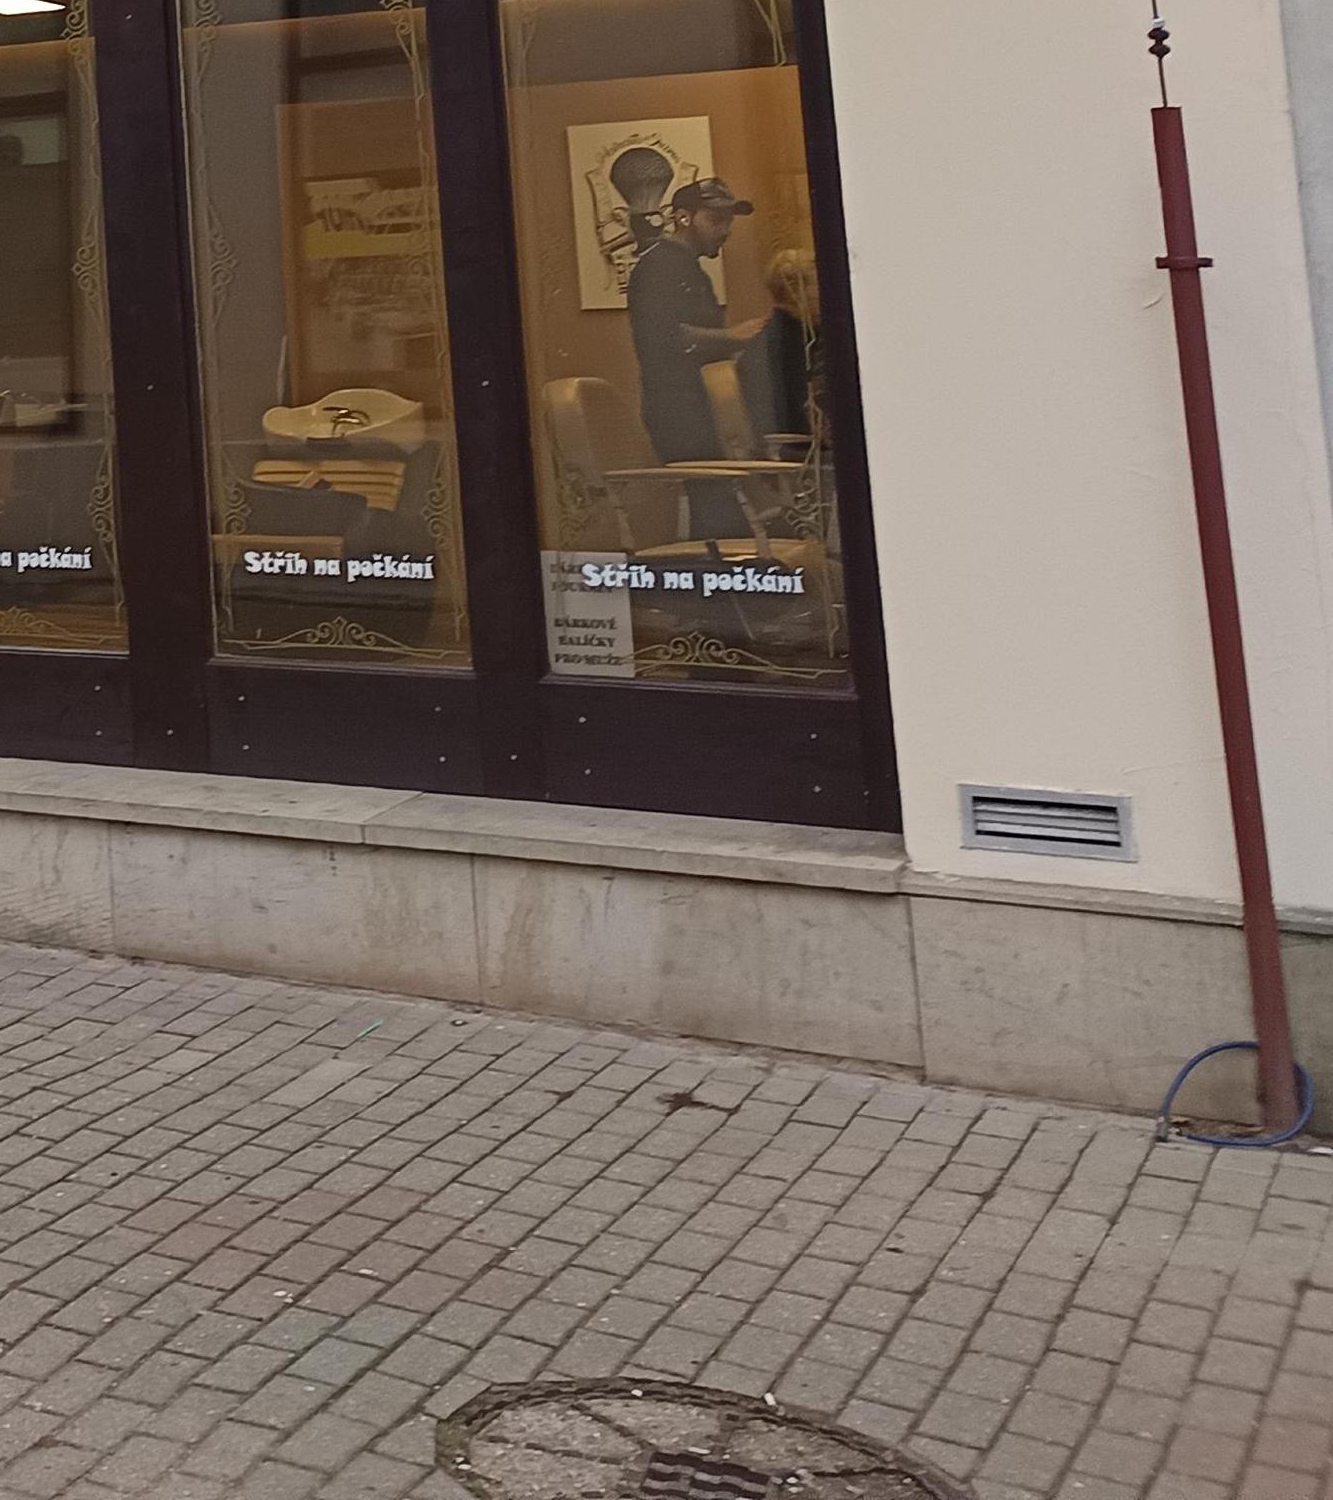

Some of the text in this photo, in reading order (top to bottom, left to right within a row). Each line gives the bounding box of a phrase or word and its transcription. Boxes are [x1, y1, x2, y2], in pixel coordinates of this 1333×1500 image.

[17, 545, 92, 573] počkání
[244, 550, 435, 582] Střih na počkání
[582, 563, 655, 589] Střih
[663, 572, 695, 590] na
[703, 566, 805, 597] počkání
